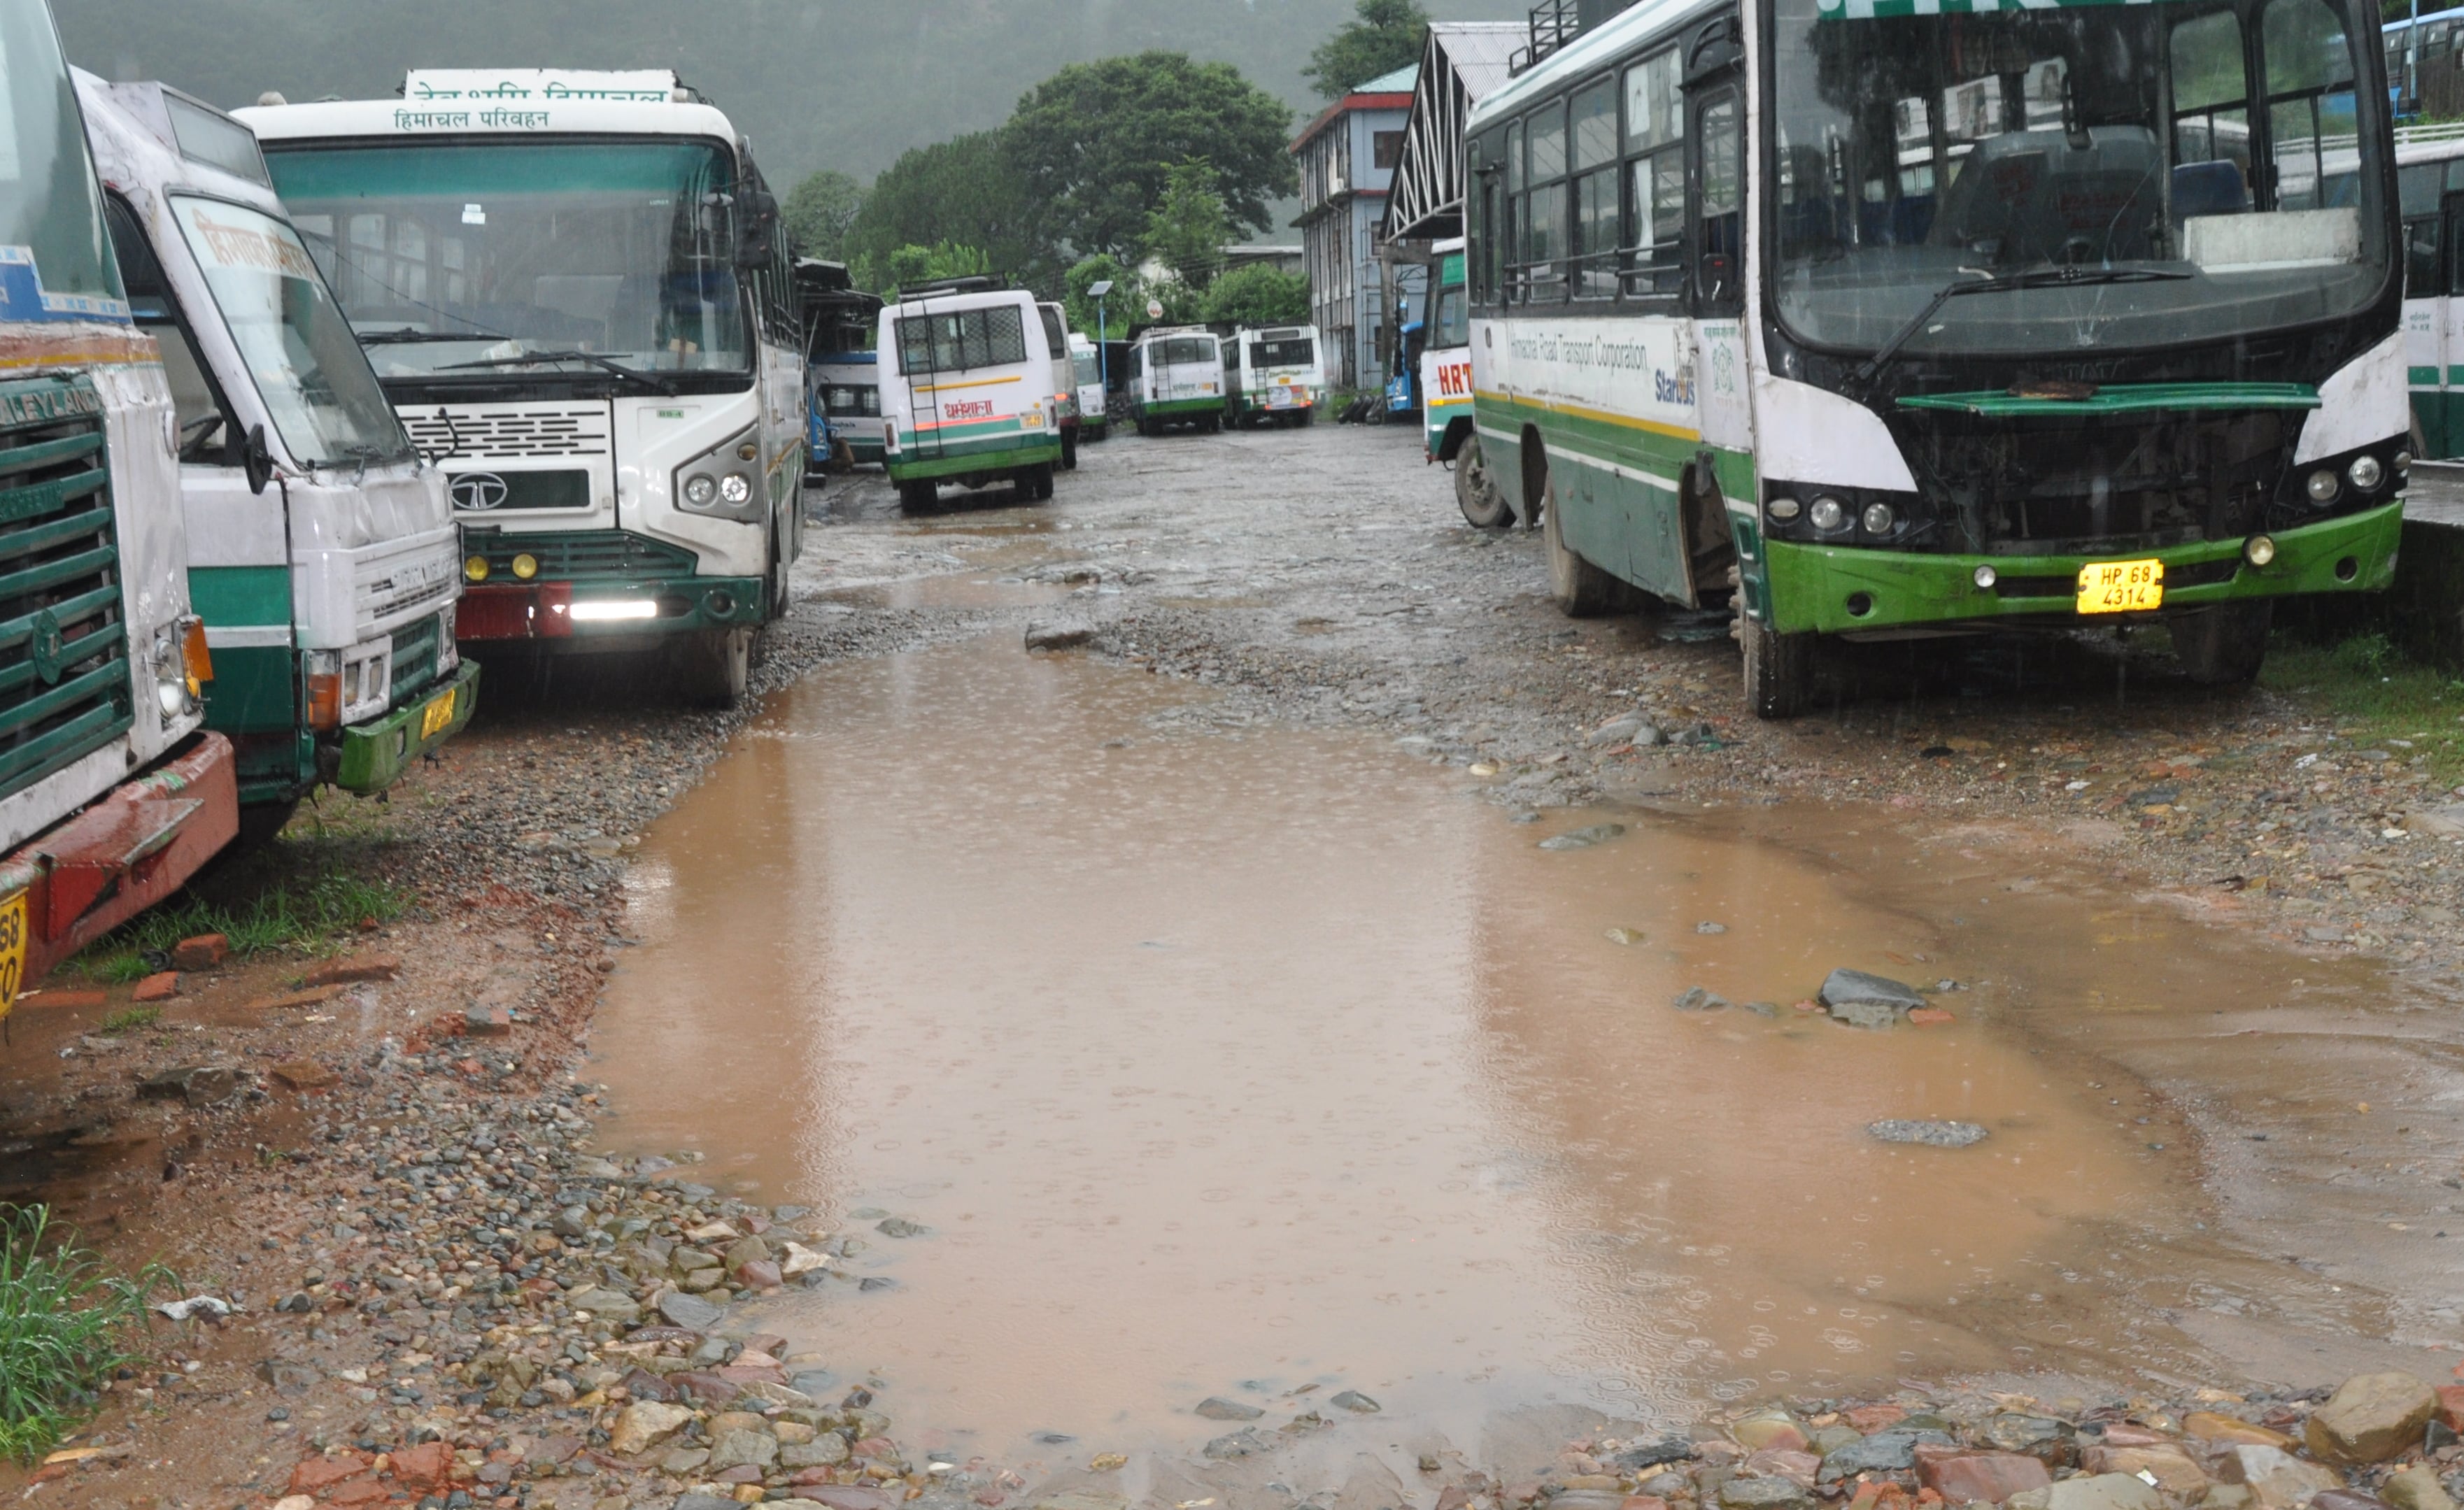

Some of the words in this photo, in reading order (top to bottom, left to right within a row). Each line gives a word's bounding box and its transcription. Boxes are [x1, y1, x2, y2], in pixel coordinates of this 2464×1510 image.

[393, 108, 469, 131] हिमाचल
[479, 107, 550, 130] परिवहन
[1510, 332, 1538, 360] Himachal
[1539, 333, 1558, 362] Road
[1558, 334, 1594, 372] Transport
[1596, 334, 1648, 376] Corporation
[2101, 567, 2122, 585] HP
[2131, 567, 2151, 583] 68
[2103, 587, 2146, 606] 4314
